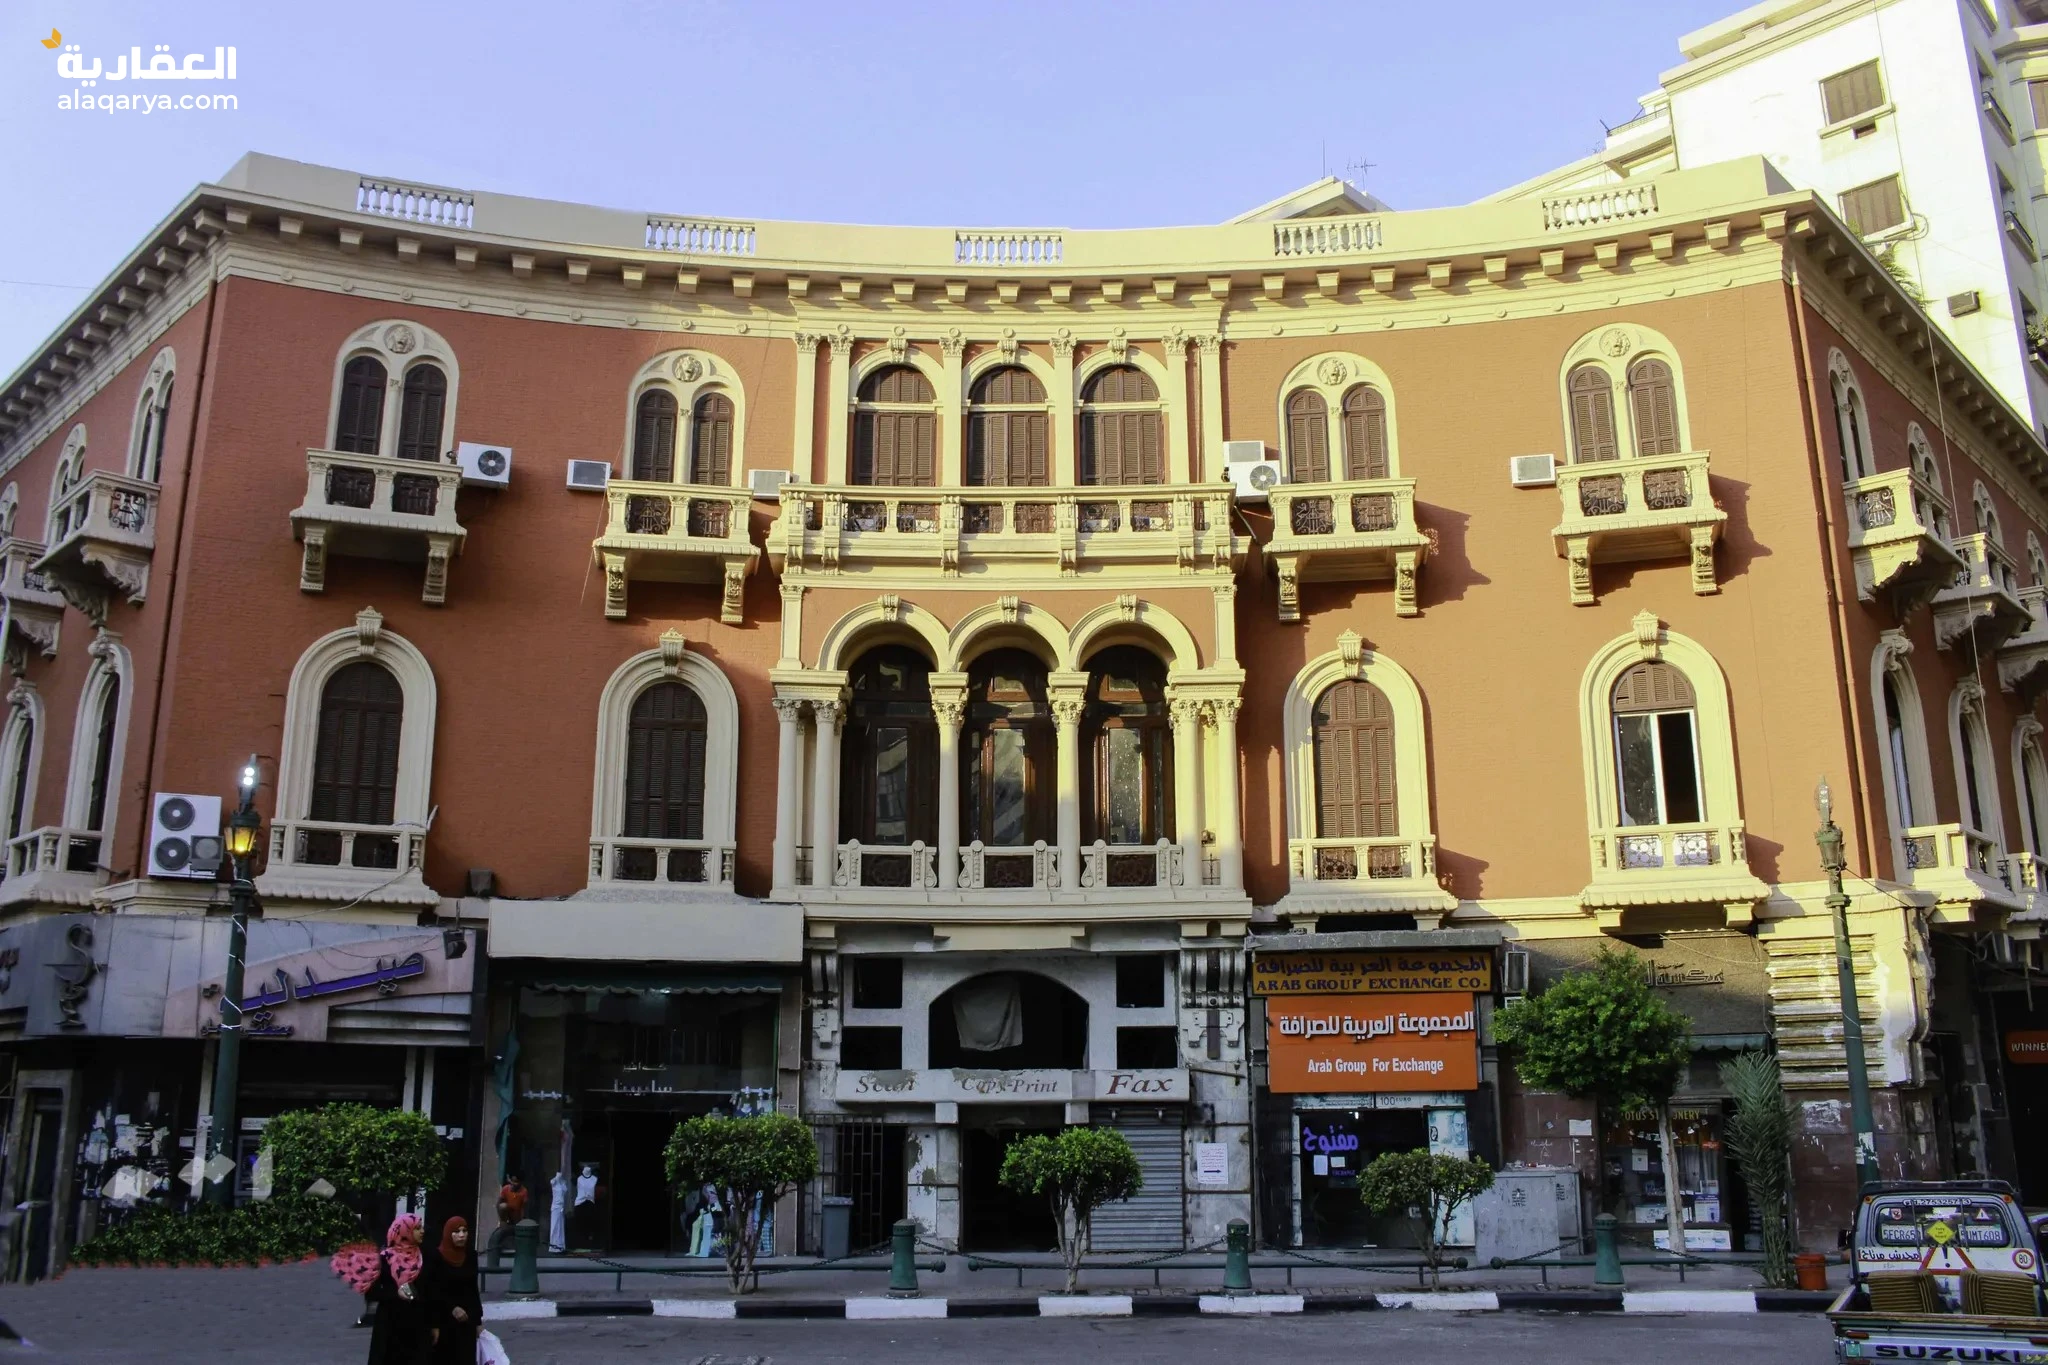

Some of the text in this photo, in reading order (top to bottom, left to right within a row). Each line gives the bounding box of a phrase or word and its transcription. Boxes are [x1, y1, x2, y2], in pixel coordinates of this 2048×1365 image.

[1330, 956, 1392, 976] العربية
[1256, 977, 1487, 991] ARAB GROUP EXCHANGE CO.
[1279, 1011, 1474, 1039] المجموعة العربية للصرافة
[2011, 1042, 2048, 1052] WINNE
[1307, 1057, 1444, 1075] Arab Group For Exchange
[1106, 1074, 1174, 1096] Fax
[1380, 1096, 1396, 1105] 100
[1621, 1110, 1647, 1121] OTUS
[1303, 1124, 1359, 1155] مفتوح
[2018, 1254, 2028, 1264] 80
[1875, 1345, 2021, 1363] SUZUKI
